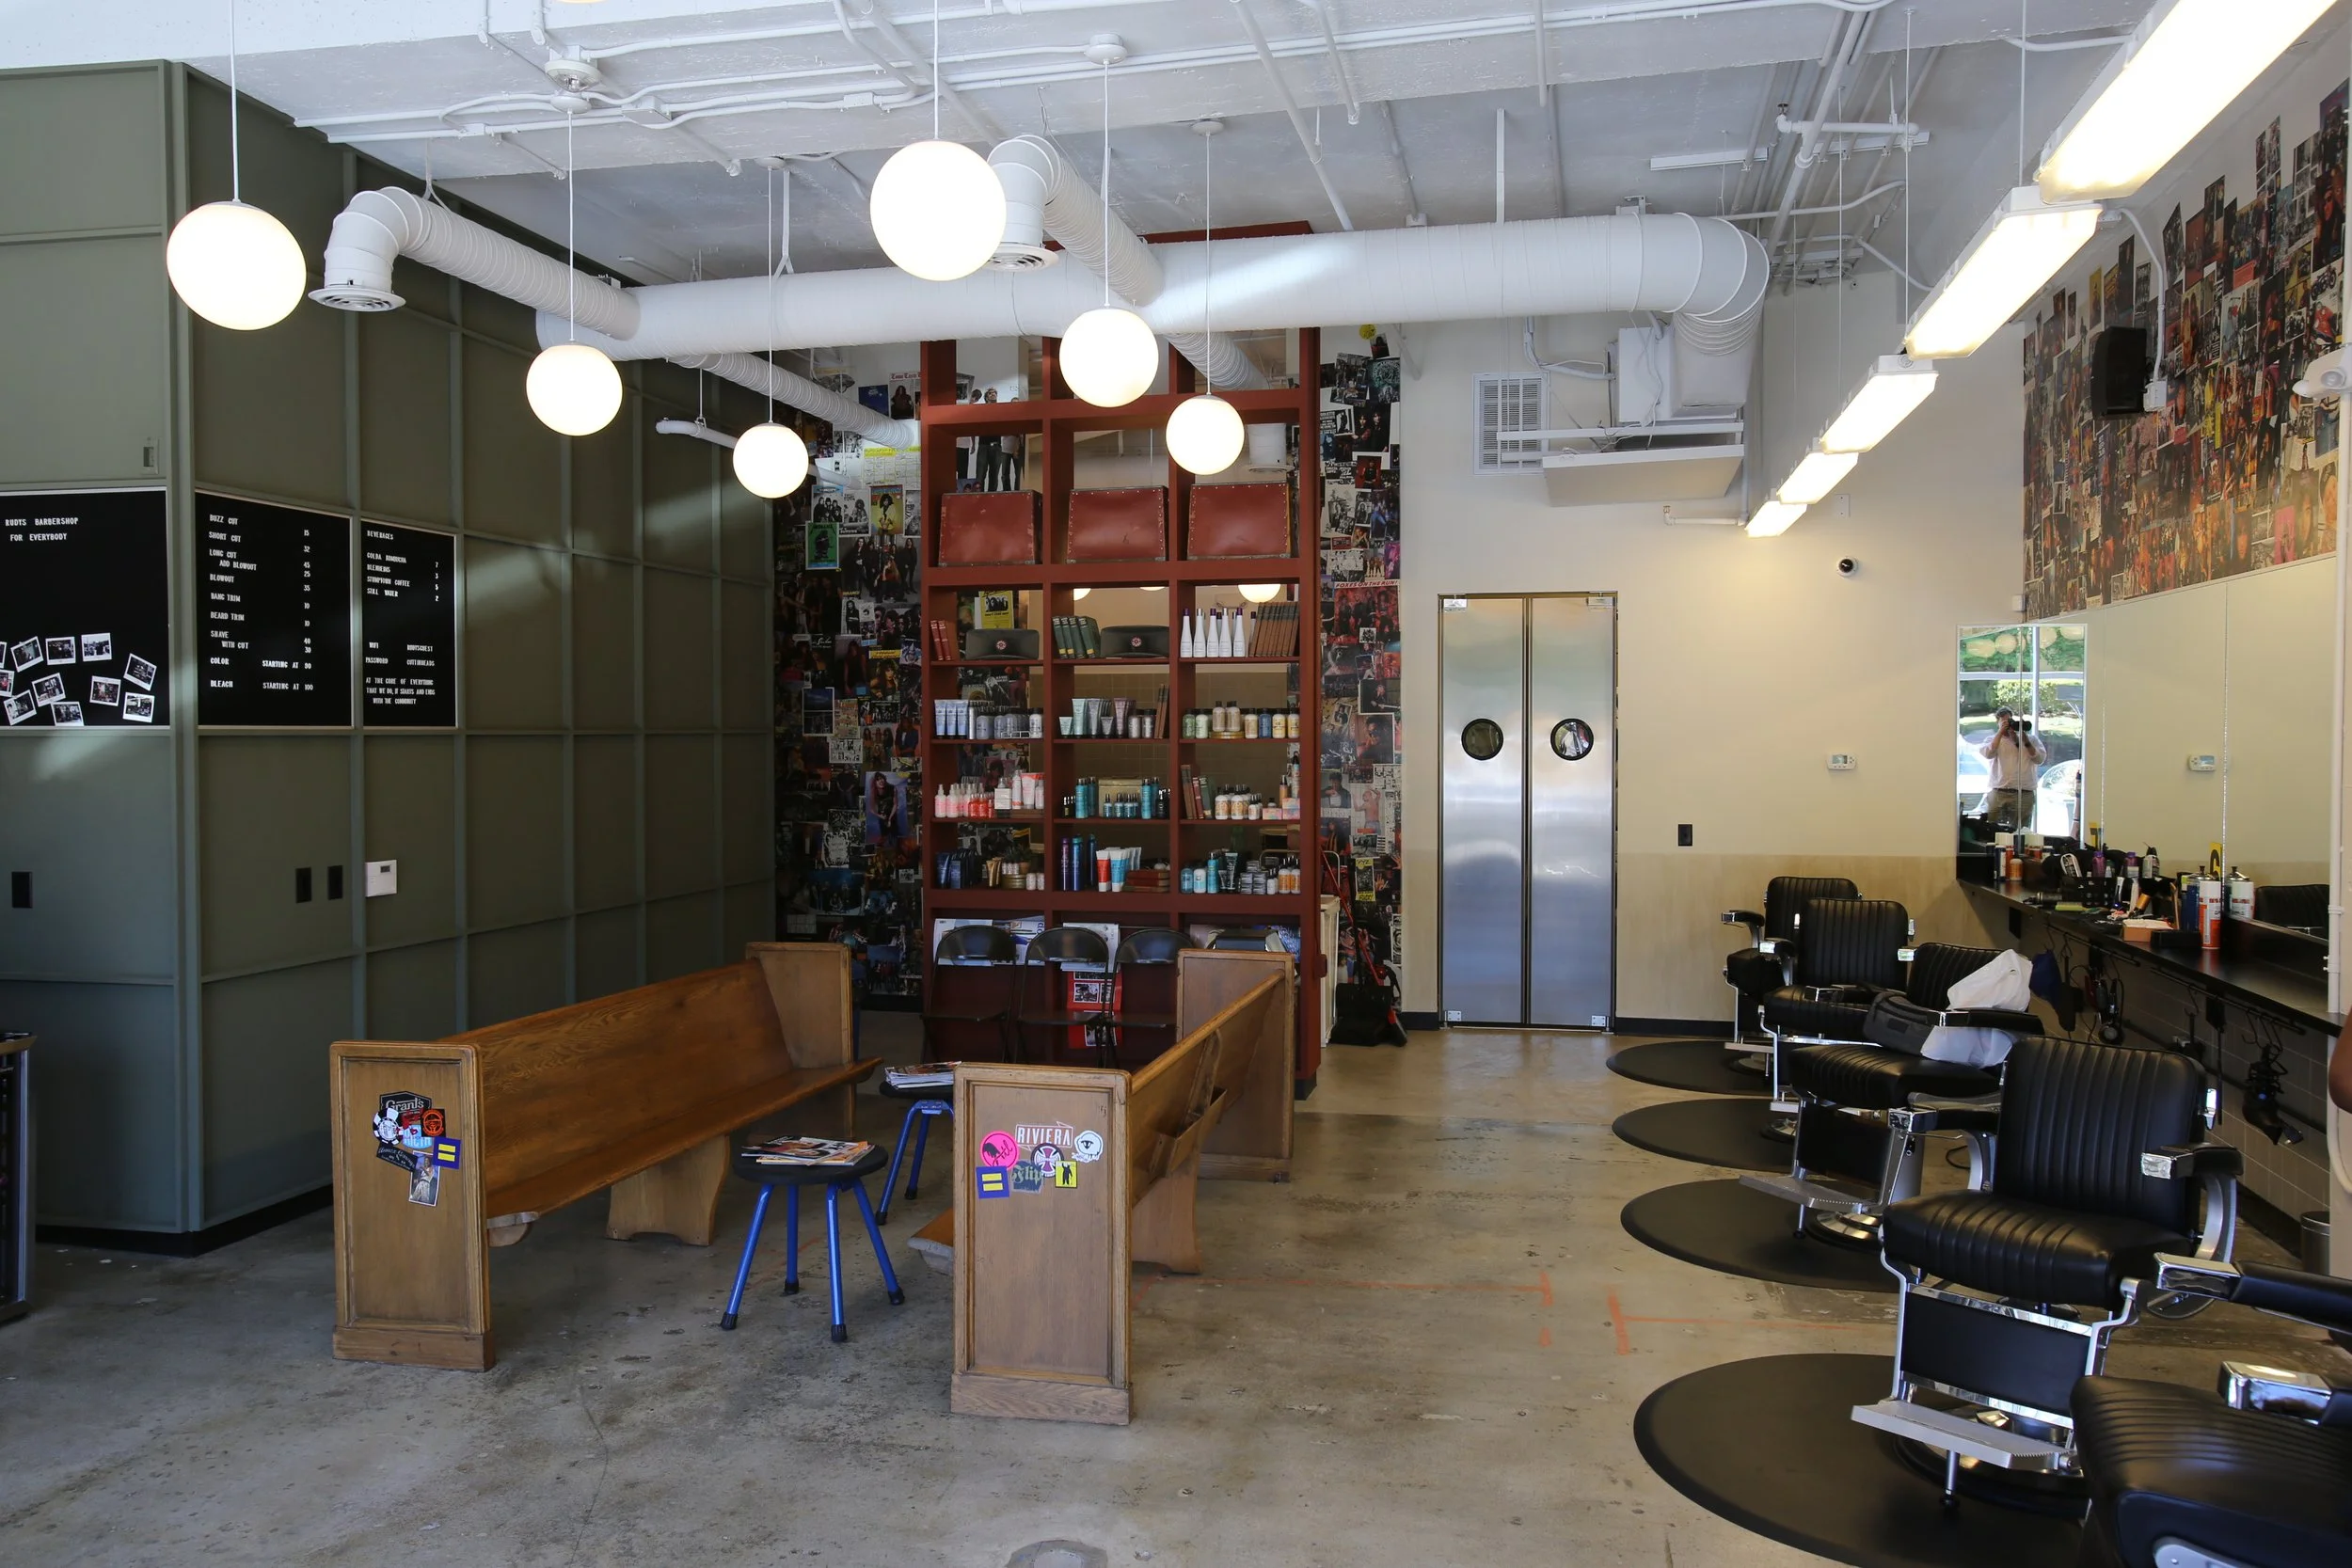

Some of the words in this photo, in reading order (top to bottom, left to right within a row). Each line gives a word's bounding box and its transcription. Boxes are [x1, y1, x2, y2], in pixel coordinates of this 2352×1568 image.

[35, 517, 78, 526] BARBERSHOP
[210, 515, 224, 523] BUZZ
[209, 531, 227, 540] SHORT
[367, 531, 393, 540] BEVERAGES
[233, 562, 257, 570] BLOWOUT
[210, 574, 234, 582] BLOWOUT
[1017, 1127, 1070, 1146] RIVIERA
